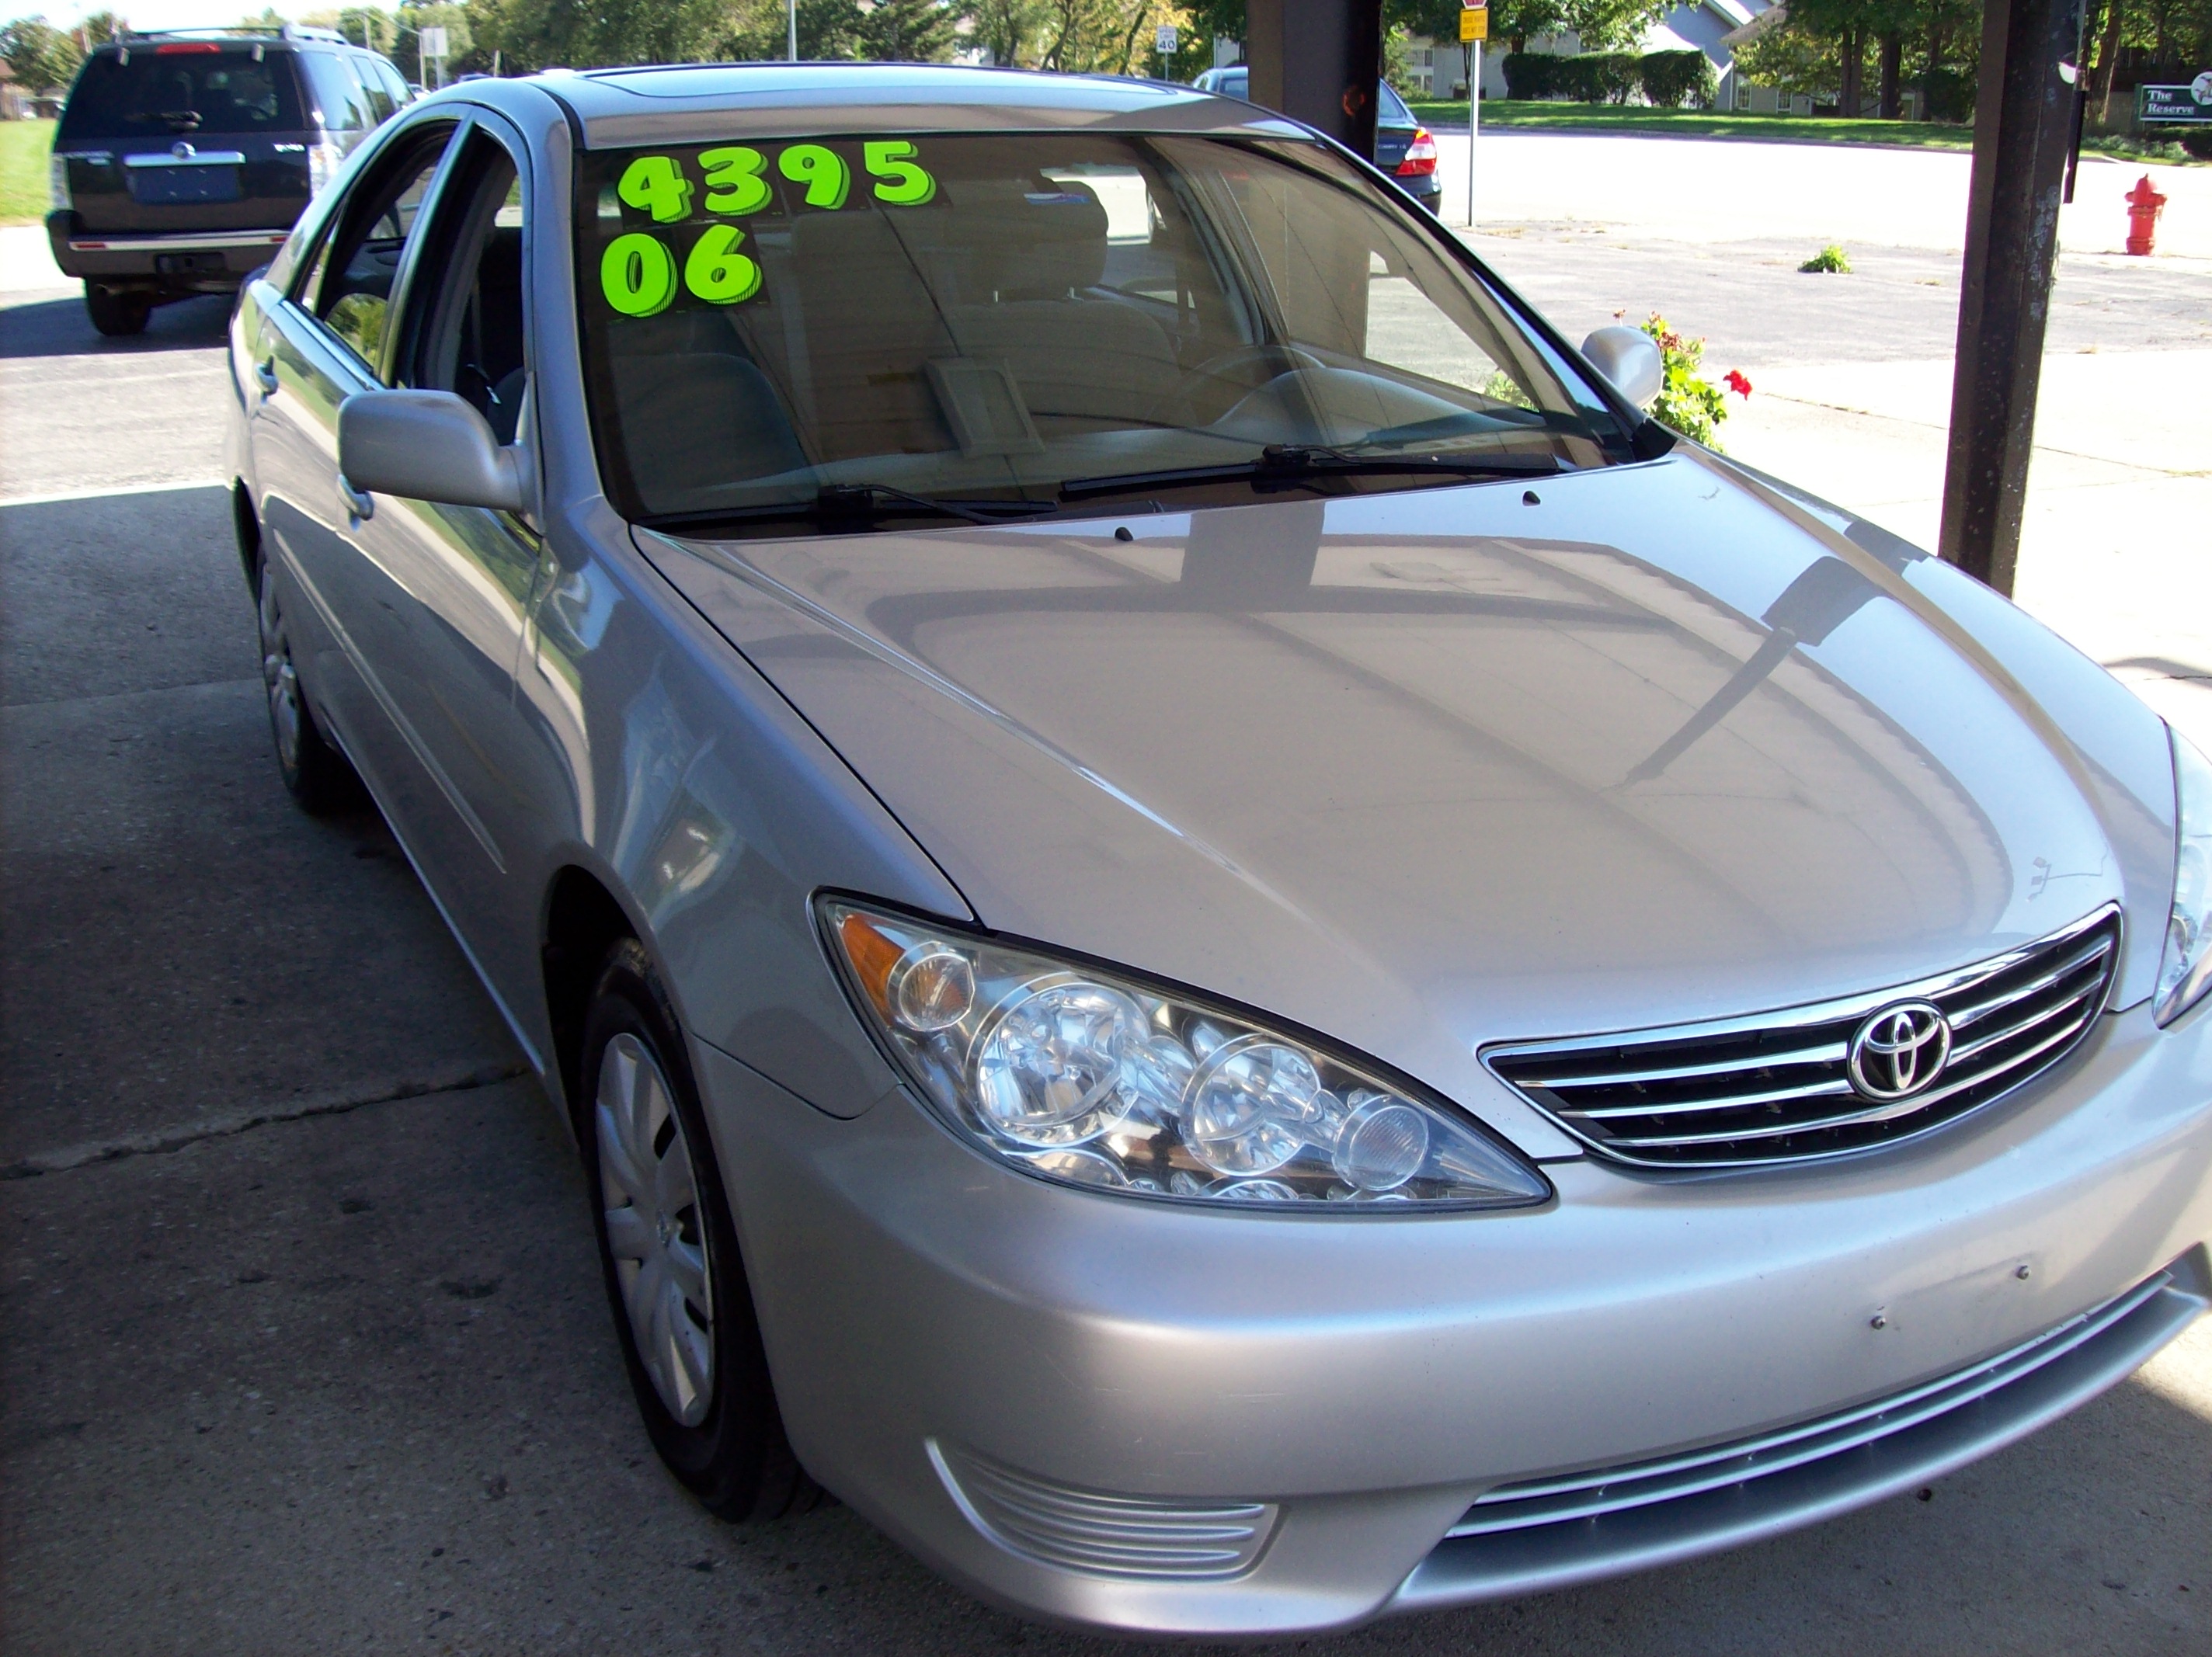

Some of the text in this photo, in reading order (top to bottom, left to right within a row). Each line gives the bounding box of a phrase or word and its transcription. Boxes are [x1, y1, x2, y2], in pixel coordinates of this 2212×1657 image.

[1158, 40, 1175, 50] 40
[2148, 90, 2172, 101] The
[2148, 103, 2194, 114] Reserve
[617, 141, 937, 224] 4395
[600, 224, 763, 318] 06
